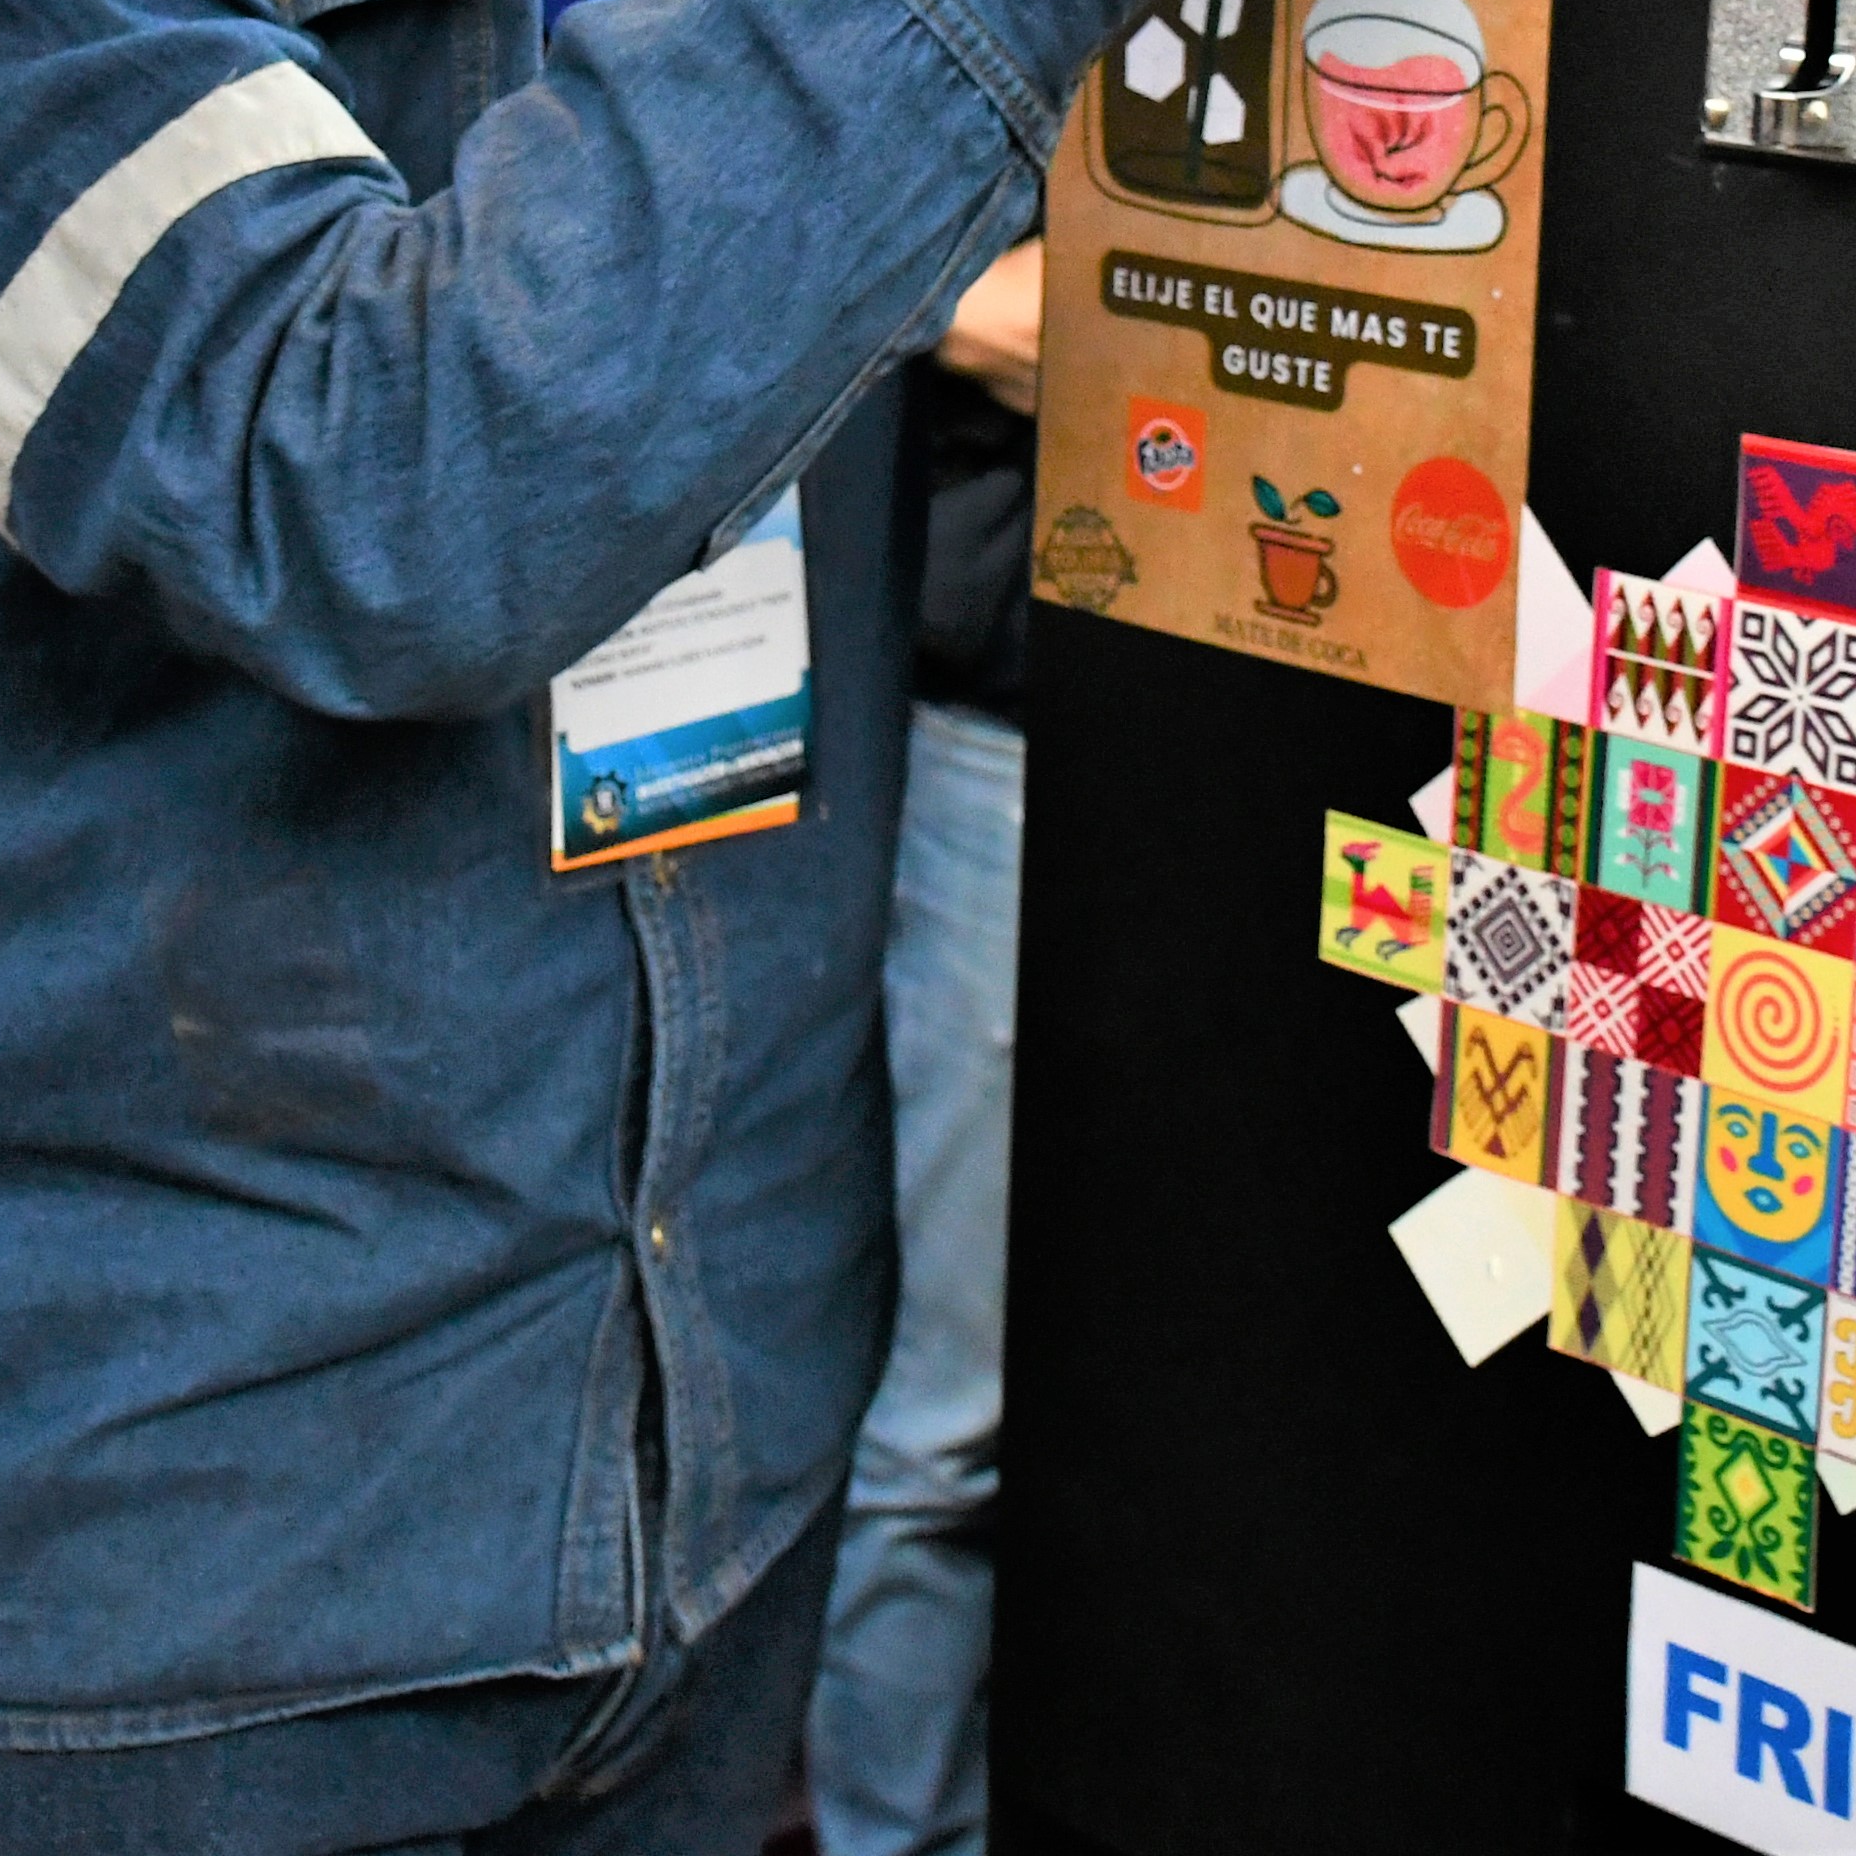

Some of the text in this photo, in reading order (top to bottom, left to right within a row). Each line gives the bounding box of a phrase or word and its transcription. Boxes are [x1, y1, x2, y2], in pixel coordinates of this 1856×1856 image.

[1112, 266, 1463, 360] ELIJE EL QUE MAS TE
[1222, 344, 1333, 393] GUSTE
